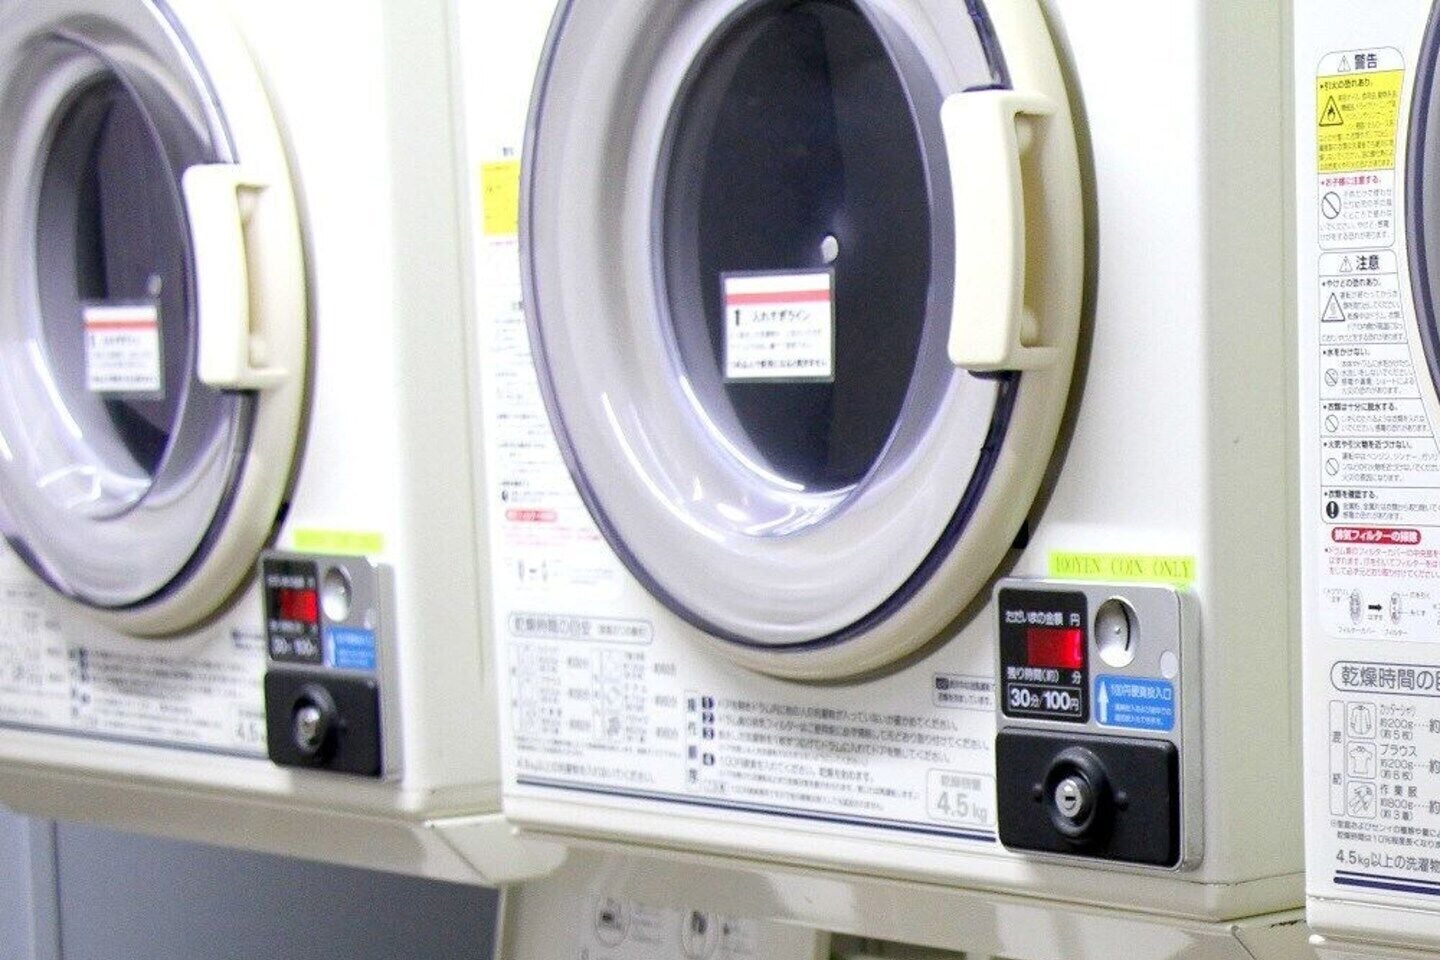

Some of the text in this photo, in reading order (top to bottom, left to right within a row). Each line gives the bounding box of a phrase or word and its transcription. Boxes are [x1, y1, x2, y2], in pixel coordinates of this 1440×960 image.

[1356, 254, 1380, 270] 注意
[1070, 612, 1081, 626] 円
[1071, 672, 1082, 684] 分
[1380, 742, 1418, 757] ブラウス
